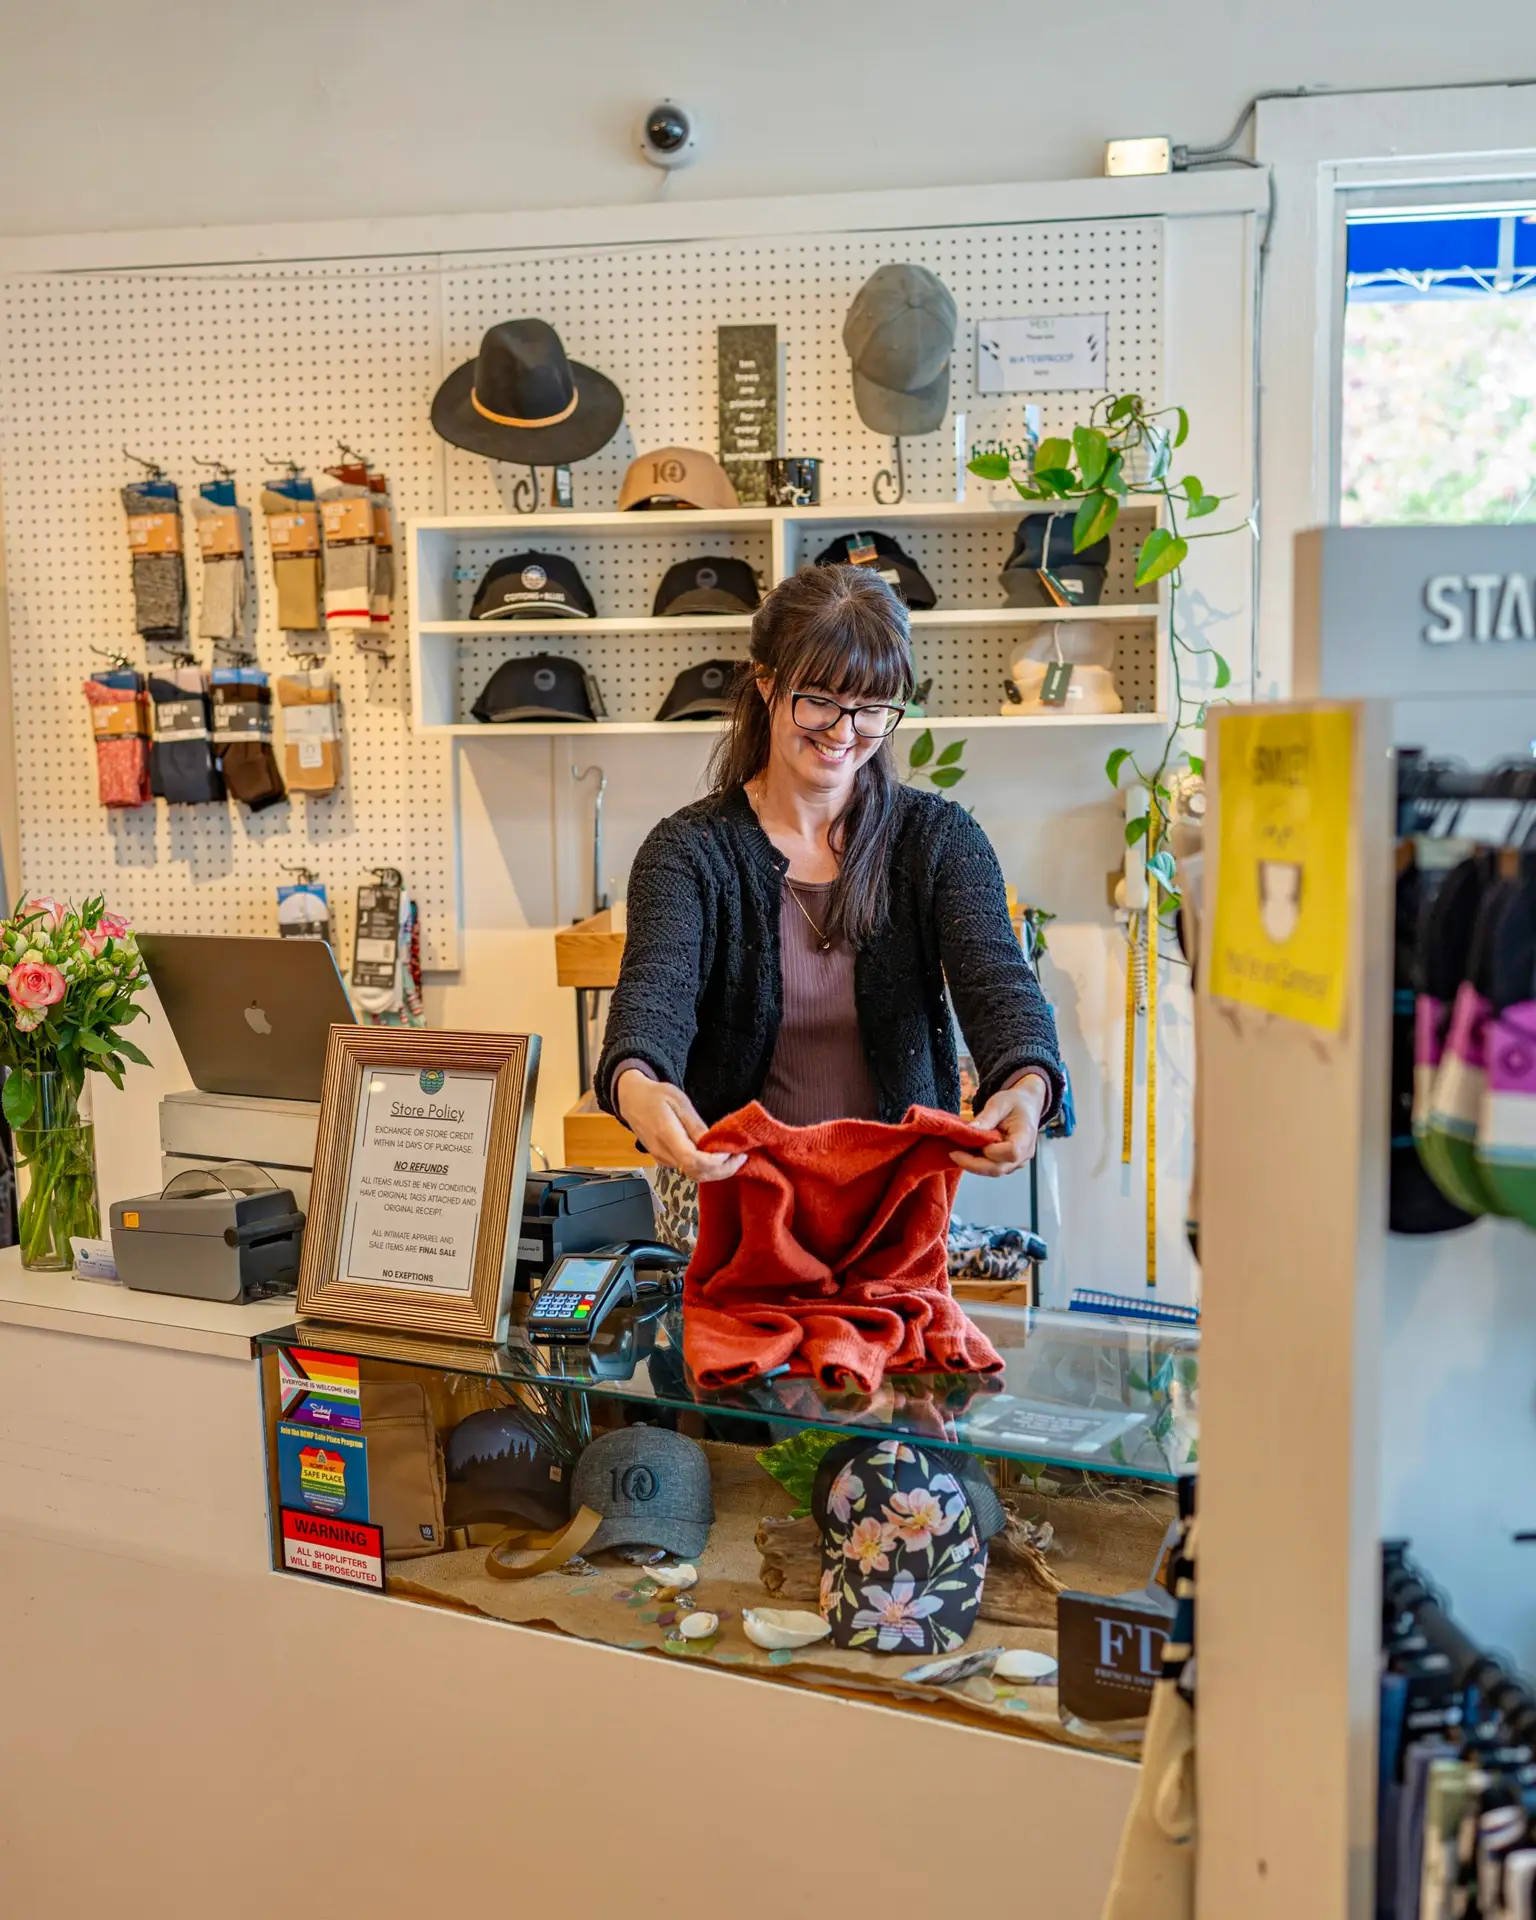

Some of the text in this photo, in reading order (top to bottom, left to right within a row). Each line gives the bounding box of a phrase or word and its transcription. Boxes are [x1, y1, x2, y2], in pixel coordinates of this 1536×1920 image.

[735, 374, 760, 382] trees
[729, 399, 766, 409] planted
[734, 426, 761, 435] every
[724, 451, 772, 462] purchased
[391, 1102, 464, 1124] Store Policy
[375, 1126, 474, 1140] EXCHANGE OR STORE CREDIT
[374, 1138, 395, 1147] WITHIN
[405, 1141, 422, 1149] DAYS
[436, 1143, 473, 1154] PURCHASE.
[394, 1161, 449, 1175] NO REFUNDS
[373, 1178, 392, 1186] ITEMS
[393, 1180, 411, 1188] MUST
[439, 1183, 478, 1194] CONDITION,
[360, 1189, 476, 1206] HAVE ORIGINAL TAGS ATTACHED AND
[384, 1204, 443, 1216] ORIGINAL RECEIPT.
[384, 1230, 410, 1240] INTIMATE
[412, 1233, 438, 1243] APPAREL
[440, 1236, 454, 1244] AND
[369, 1241, 456, 1257] SALE ITEMS ARE FINAL SALE
[382, 1269, 433, 1282] NO EXEPTIONS
[282, 1378, 309, 1388] EVERYONE
[316, 1384, 342, 1392] WELCOME
[281, 1427, 290, 1435] Join
[300, 1430, 313, 1439] RCMP
[315, 1433, 326, 1442] Safe
[327, 1435, 340, 1444] Place
[341, 1438, 363, 1448] Program
[304, 1470, 342, 1483] SAFE PLACE
[294, 1518, 367, 1546] WARNING
[297, 1547, 367, 1569] ALL SHOPLIFTERS
[290, 1556, 377, 1582] WILL BE PROSECUTED
